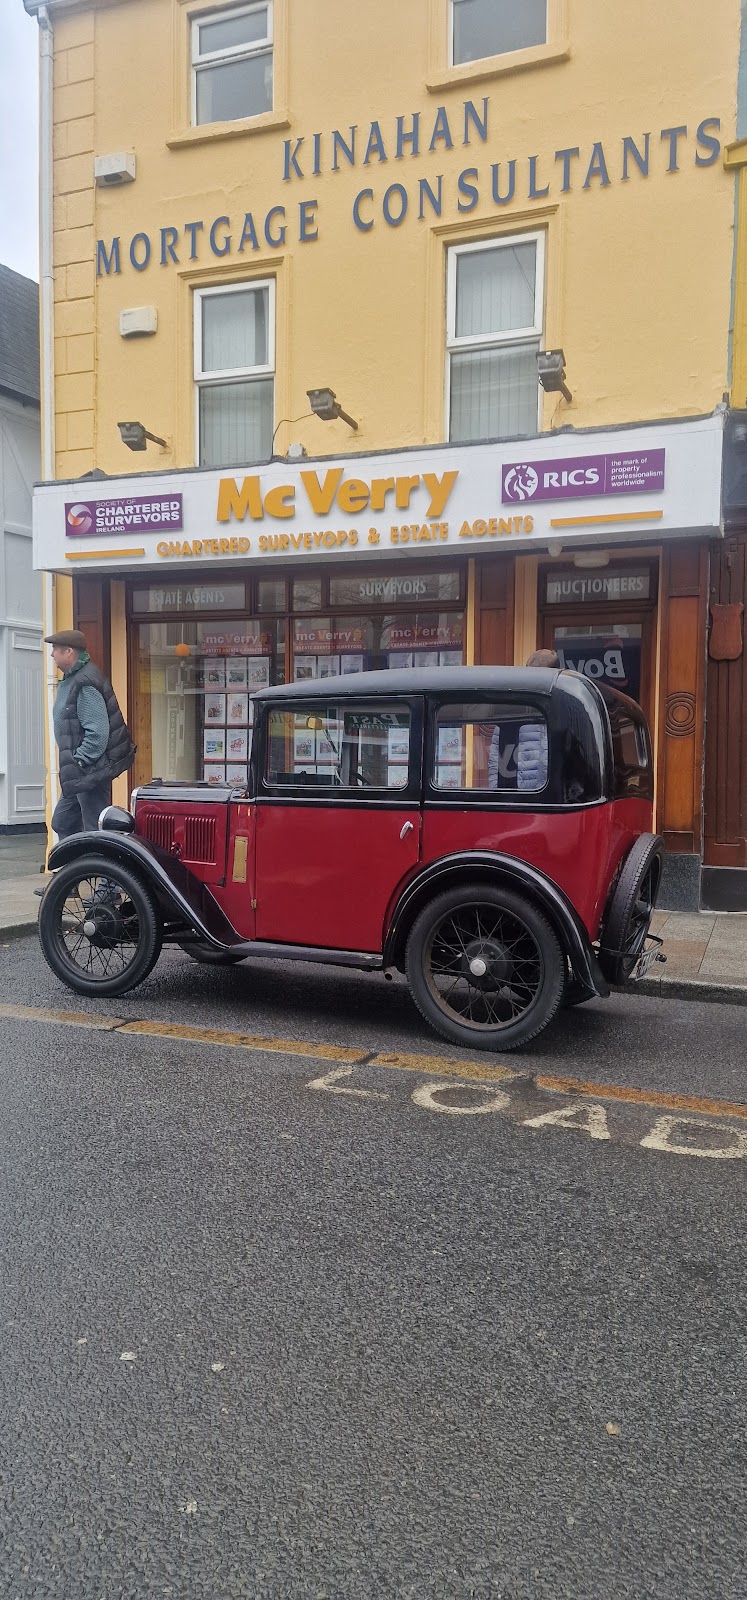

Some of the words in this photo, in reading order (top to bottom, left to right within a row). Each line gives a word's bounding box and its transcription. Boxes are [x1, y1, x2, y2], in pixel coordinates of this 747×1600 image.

[282, 97, 491, 181] KINAHAN
[96, 200, 319, 277] MORTGAGE
[353, 117, 722, 232] CONSULTANTS
[611, 465, 640, 474] property
[611, 470, 663, 481] professionalism
[543, 468, 600, 488] RICS
[611, 479, 645, 487] worldwide
[96, 501, 180, 517] CHARTERED
[96, 511, 180, 527] SURVEYORS
[156, 537, 250, 557] CHARTERED
[367, 527, 380, 544] &
[390, 522, 449, 543] ESTATE
[459, 515, 534, 537] AGENTS
[360, 580, 427, 597] SURVEYORS
[553, 576, 644, 595] AUCTIONEERS
[150, 590, 182, 605] STATE
[186, 590, 225, 604] AGENTS
